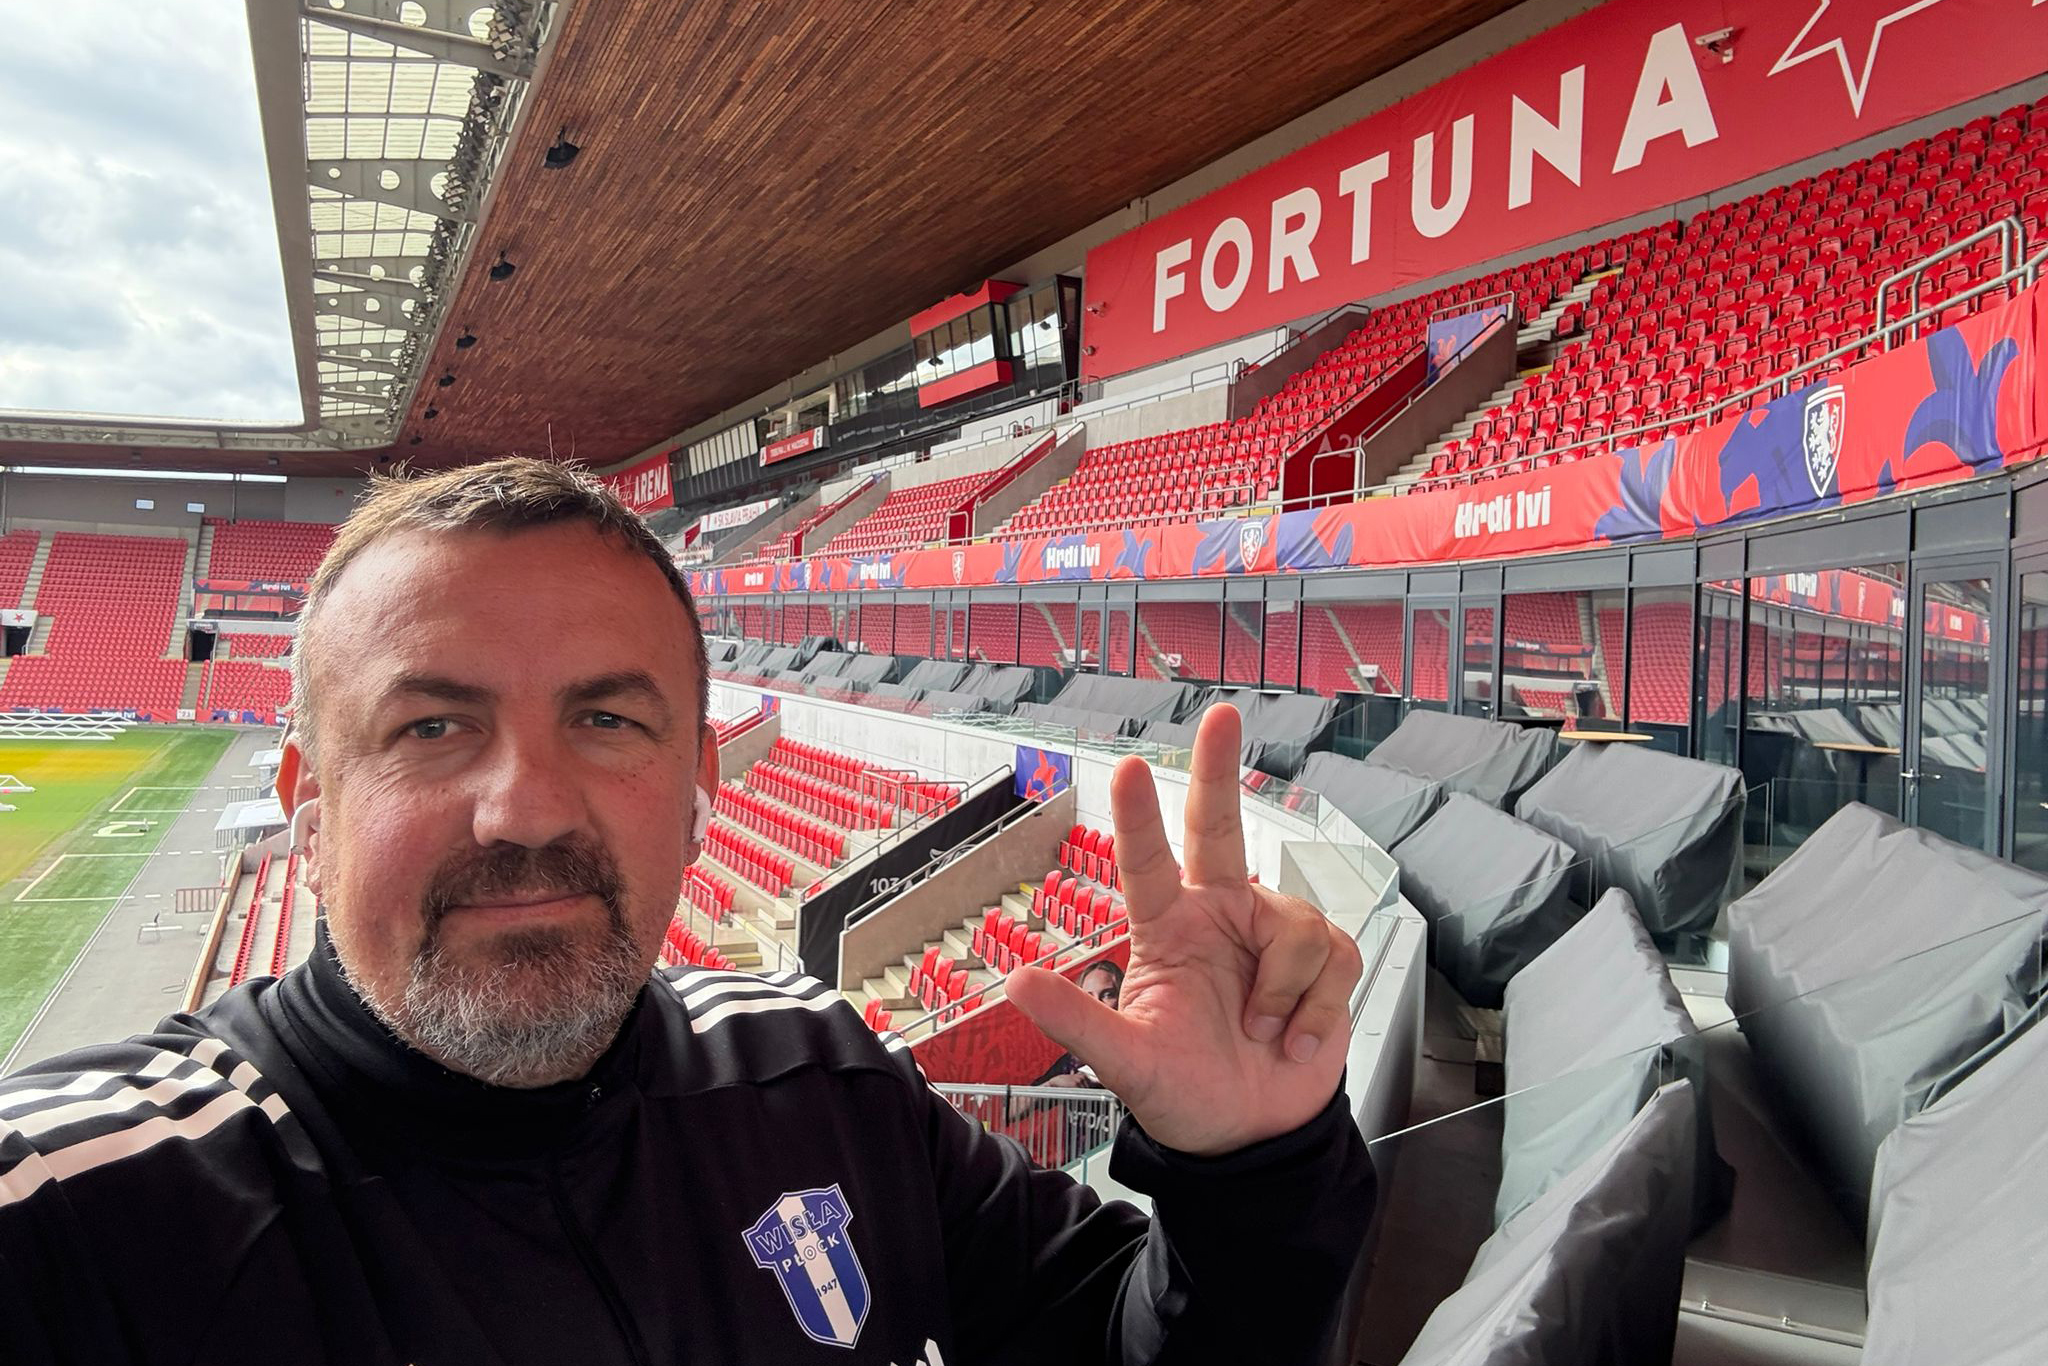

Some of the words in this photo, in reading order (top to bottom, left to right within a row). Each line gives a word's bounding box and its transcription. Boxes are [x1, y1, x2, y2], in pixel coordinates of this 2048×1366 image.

[1152, 22, 1719, 334] FORTUNA
[633, 463, 669, 506] ARENA
[1454, 493, 1512, 539] Hrdí
[1046, 545, 1079, 569] Hrdí
[755, 1200, 842, 1255] WISŁA
[781, 1232, 840, 1273] PŁOCK
[816, 1278, 838, 1298] 1947
